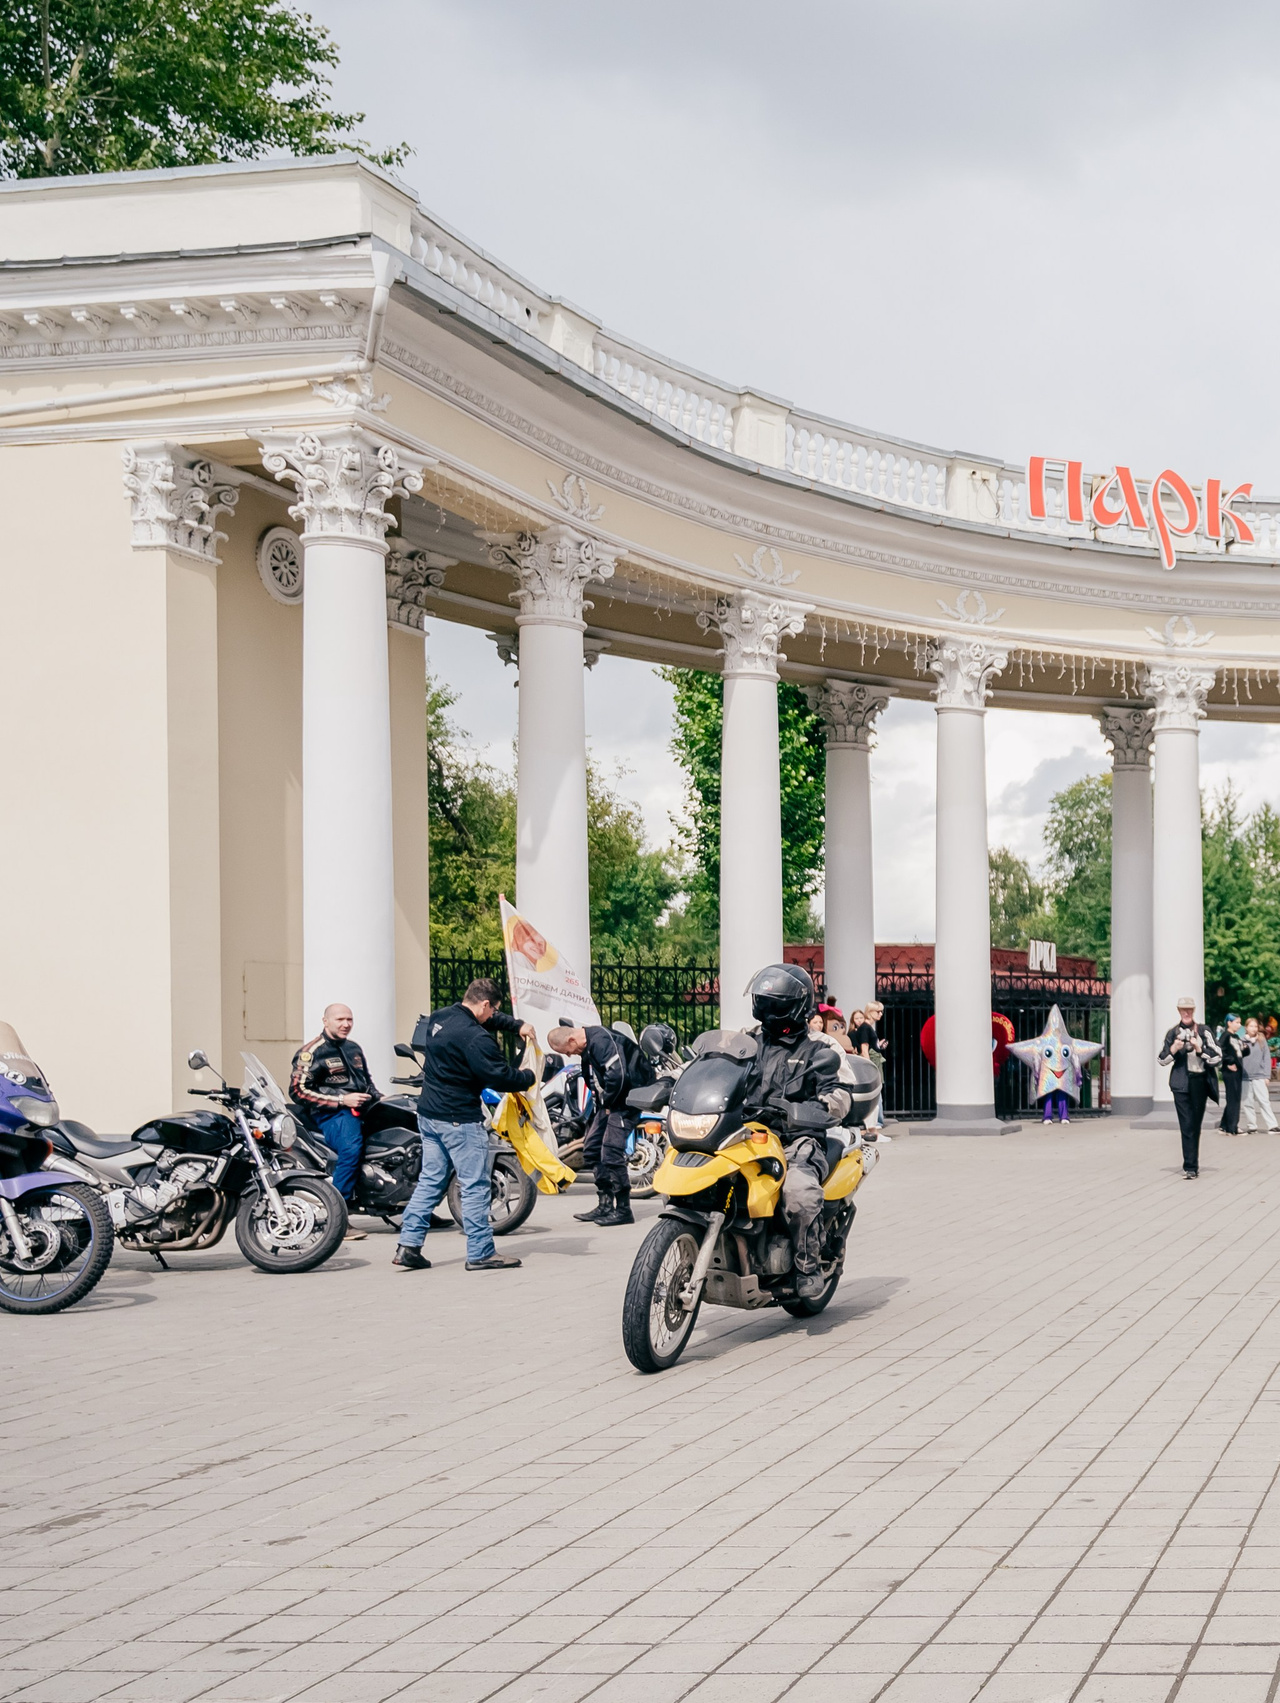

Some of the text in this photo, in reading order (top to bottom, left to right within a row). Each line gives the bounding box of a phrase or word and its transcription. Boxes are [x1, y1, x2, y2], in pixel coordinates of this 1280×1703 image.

[1028, 939, 1057, 973] АРКА
[514, 976, 559, 993] ПОМОЖЕМ
[565, 977, 580, 987] 265
